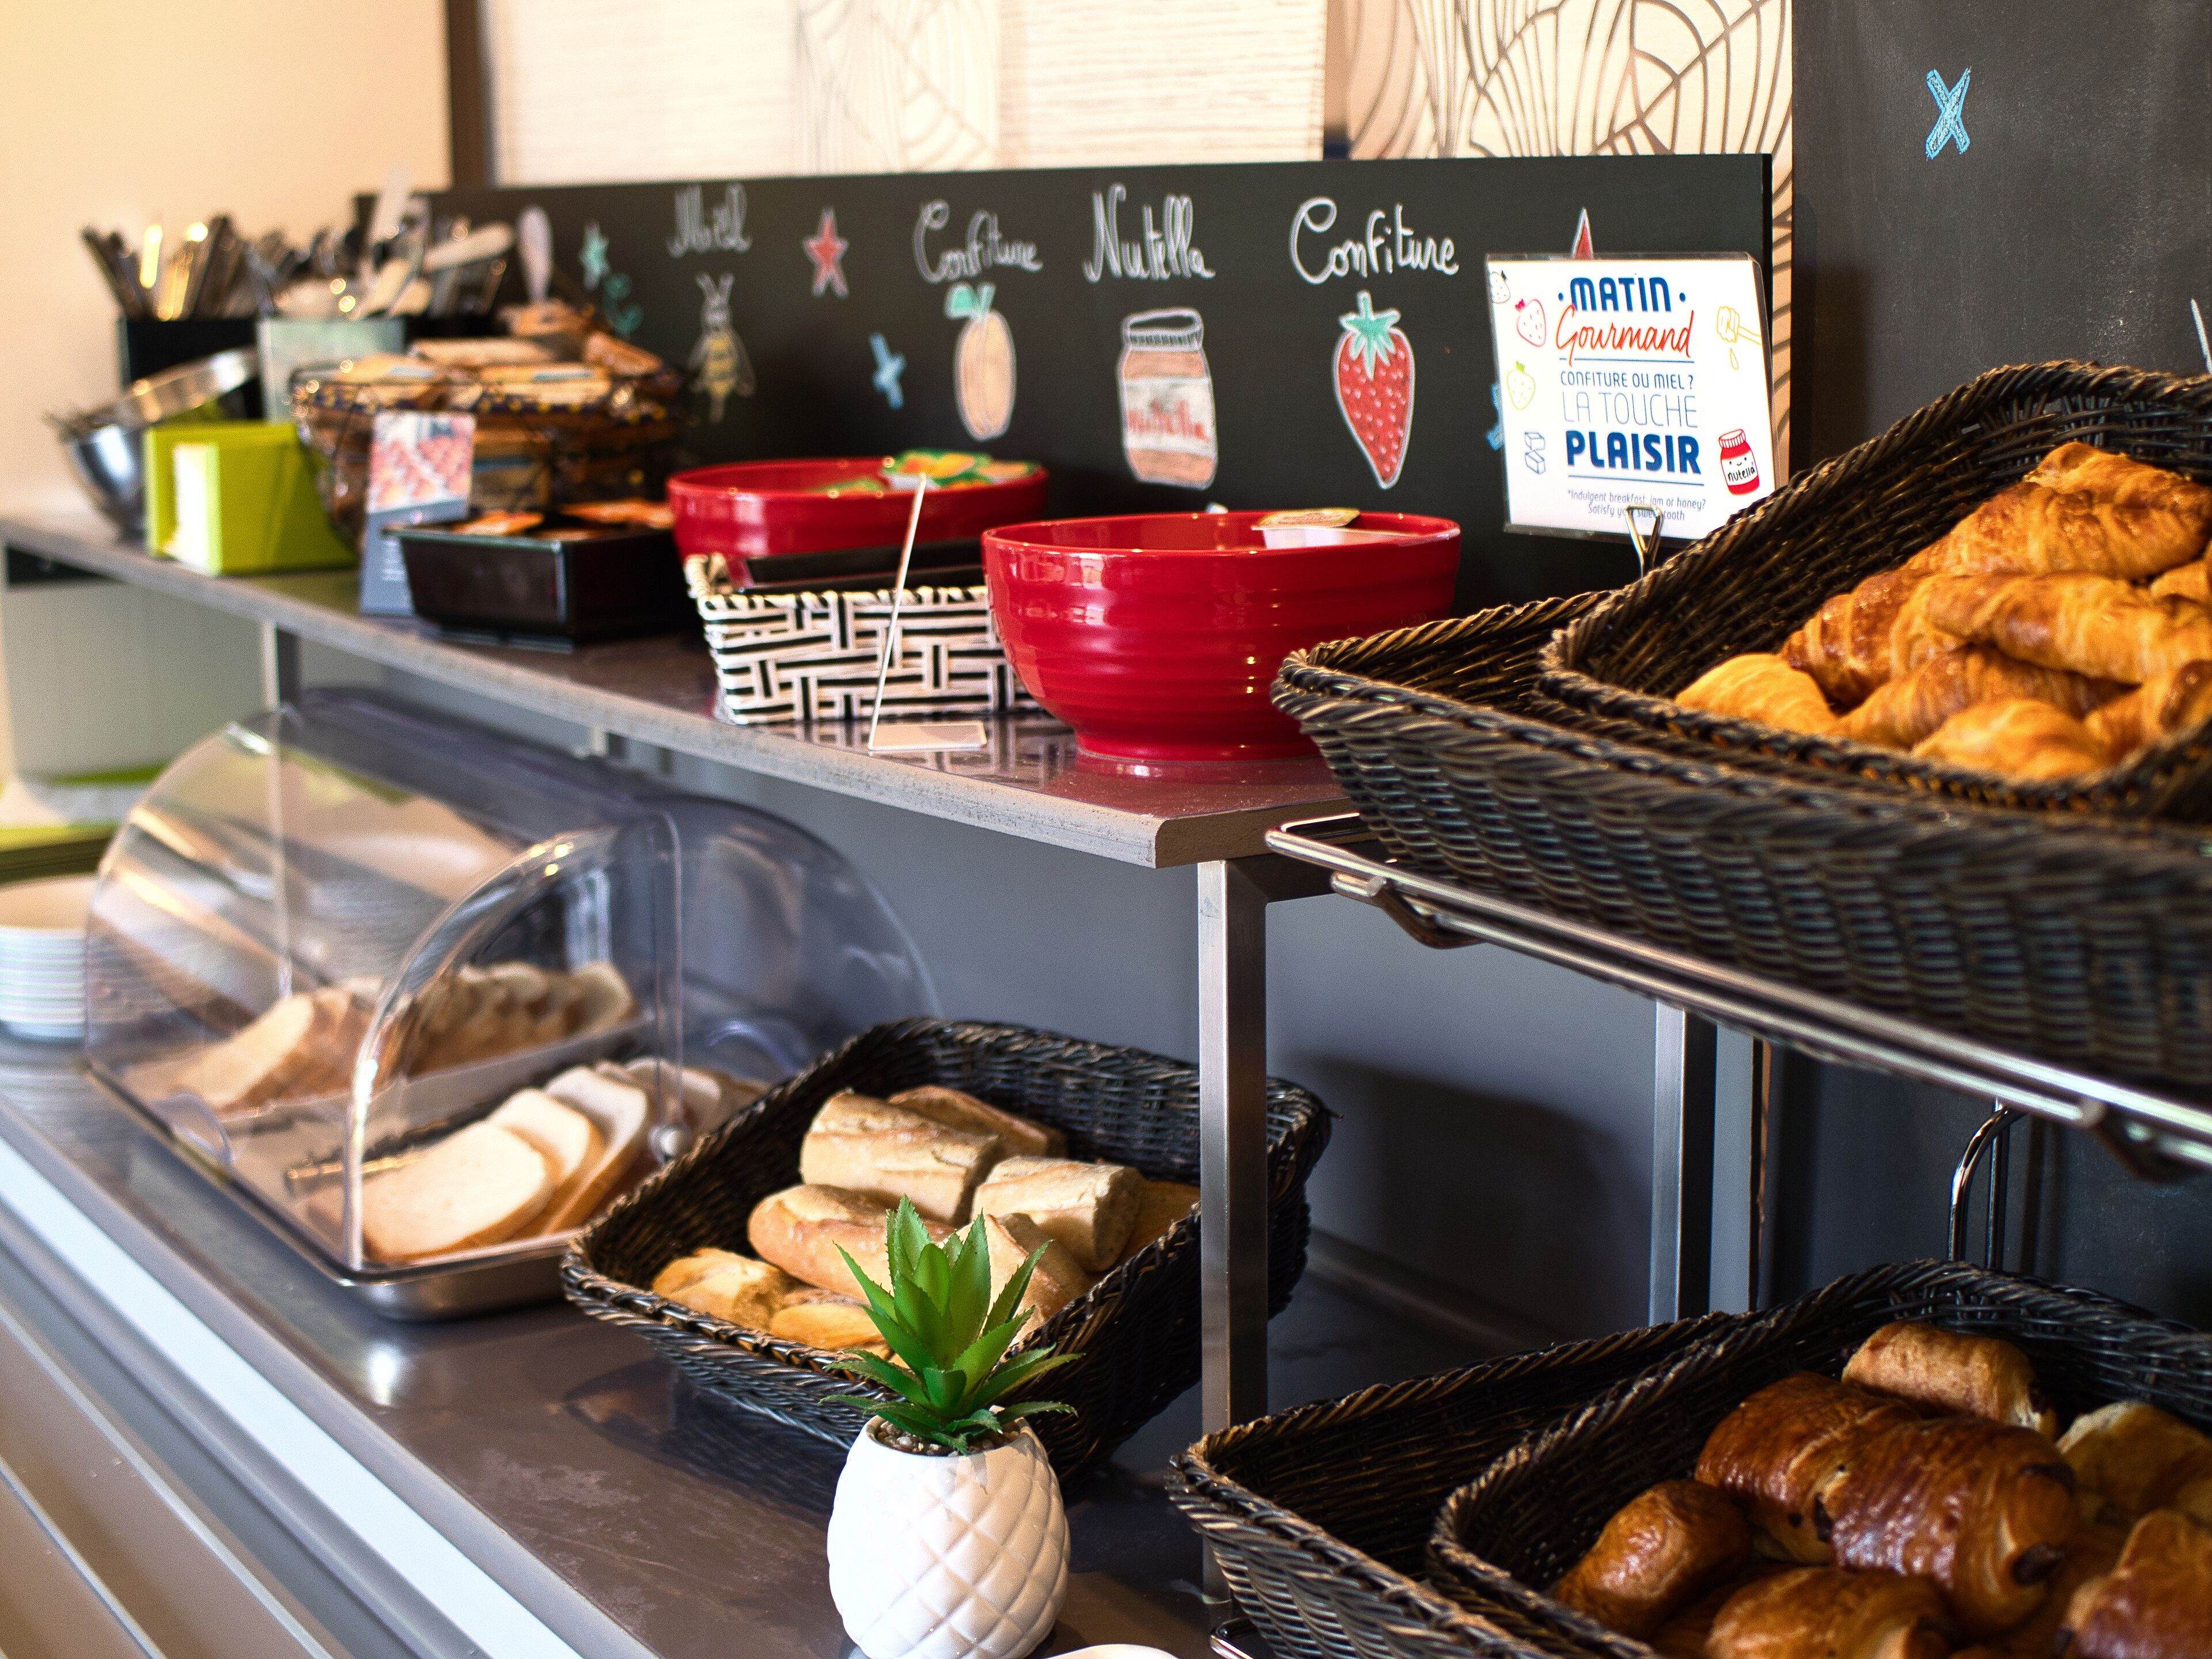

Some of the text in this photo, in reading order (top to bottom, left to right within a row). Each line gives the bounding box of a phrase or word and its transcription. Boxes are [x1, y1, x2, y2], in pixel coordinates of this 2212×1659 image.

[913, 199, 1044, 283] Confiture
[1083, 183, 1216, 283] Nutella
[1289, 196, 1459, 285] Confiture
[1570, 276, 1672, 313] MATIN
[1556, 303, 1694, 368] Gourmand
[1560, 370, 1628, 388] CONFITURE
[1632, 372, 1649, 389] OU
[1654, 373, 1685, 390] MIEL
[1562, 391, 1698, 428] LA TOUCHE
[1565, 429, 1702, 474] PLAISIR
[1728, 465, 1756, 483] nutella
[1588, 501, 1615, 517] Satisfy
[1666, 498, 1675, 507] or
[1677, 497, 1706, 512] honey?
